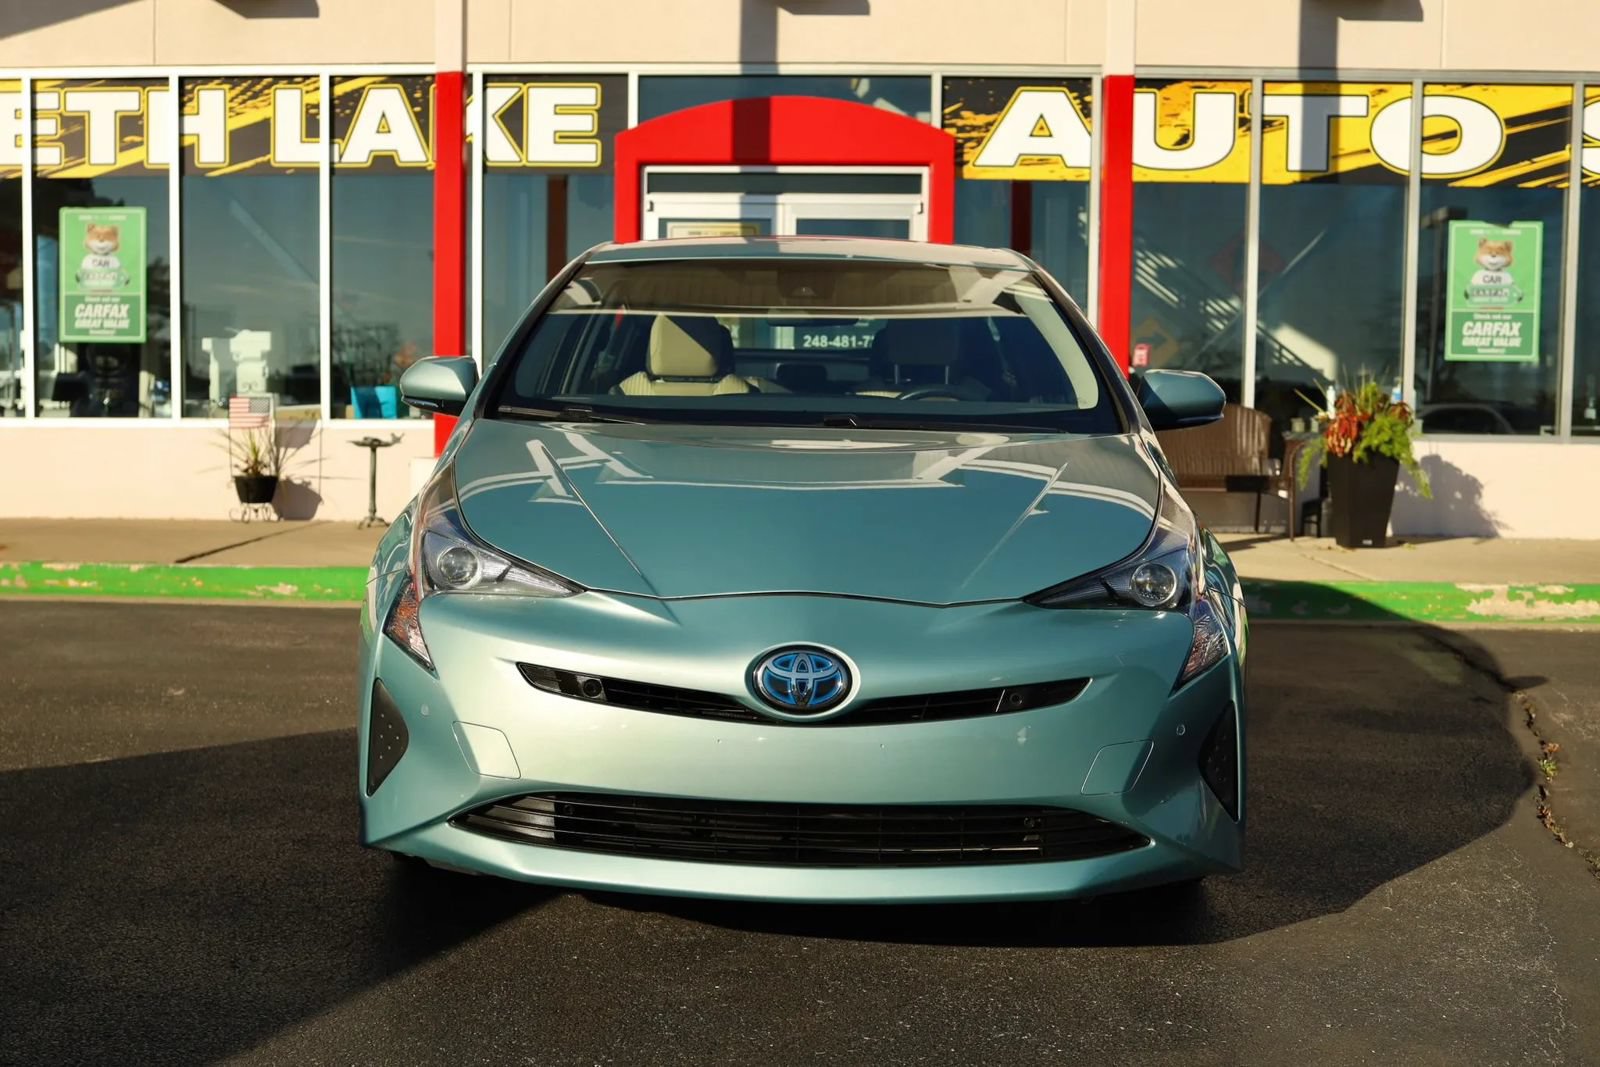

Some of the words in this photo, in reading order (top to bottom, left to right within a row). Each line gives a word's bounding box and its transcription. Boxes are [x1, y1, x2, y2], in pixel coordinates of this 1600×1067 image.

[271, 84, 602, 168] LAKE
[971, 84, 1507, 179] AUTO
[75, 304, 129, 318] CARFAX
[1462, 321, 1522, 336] CARFAX
